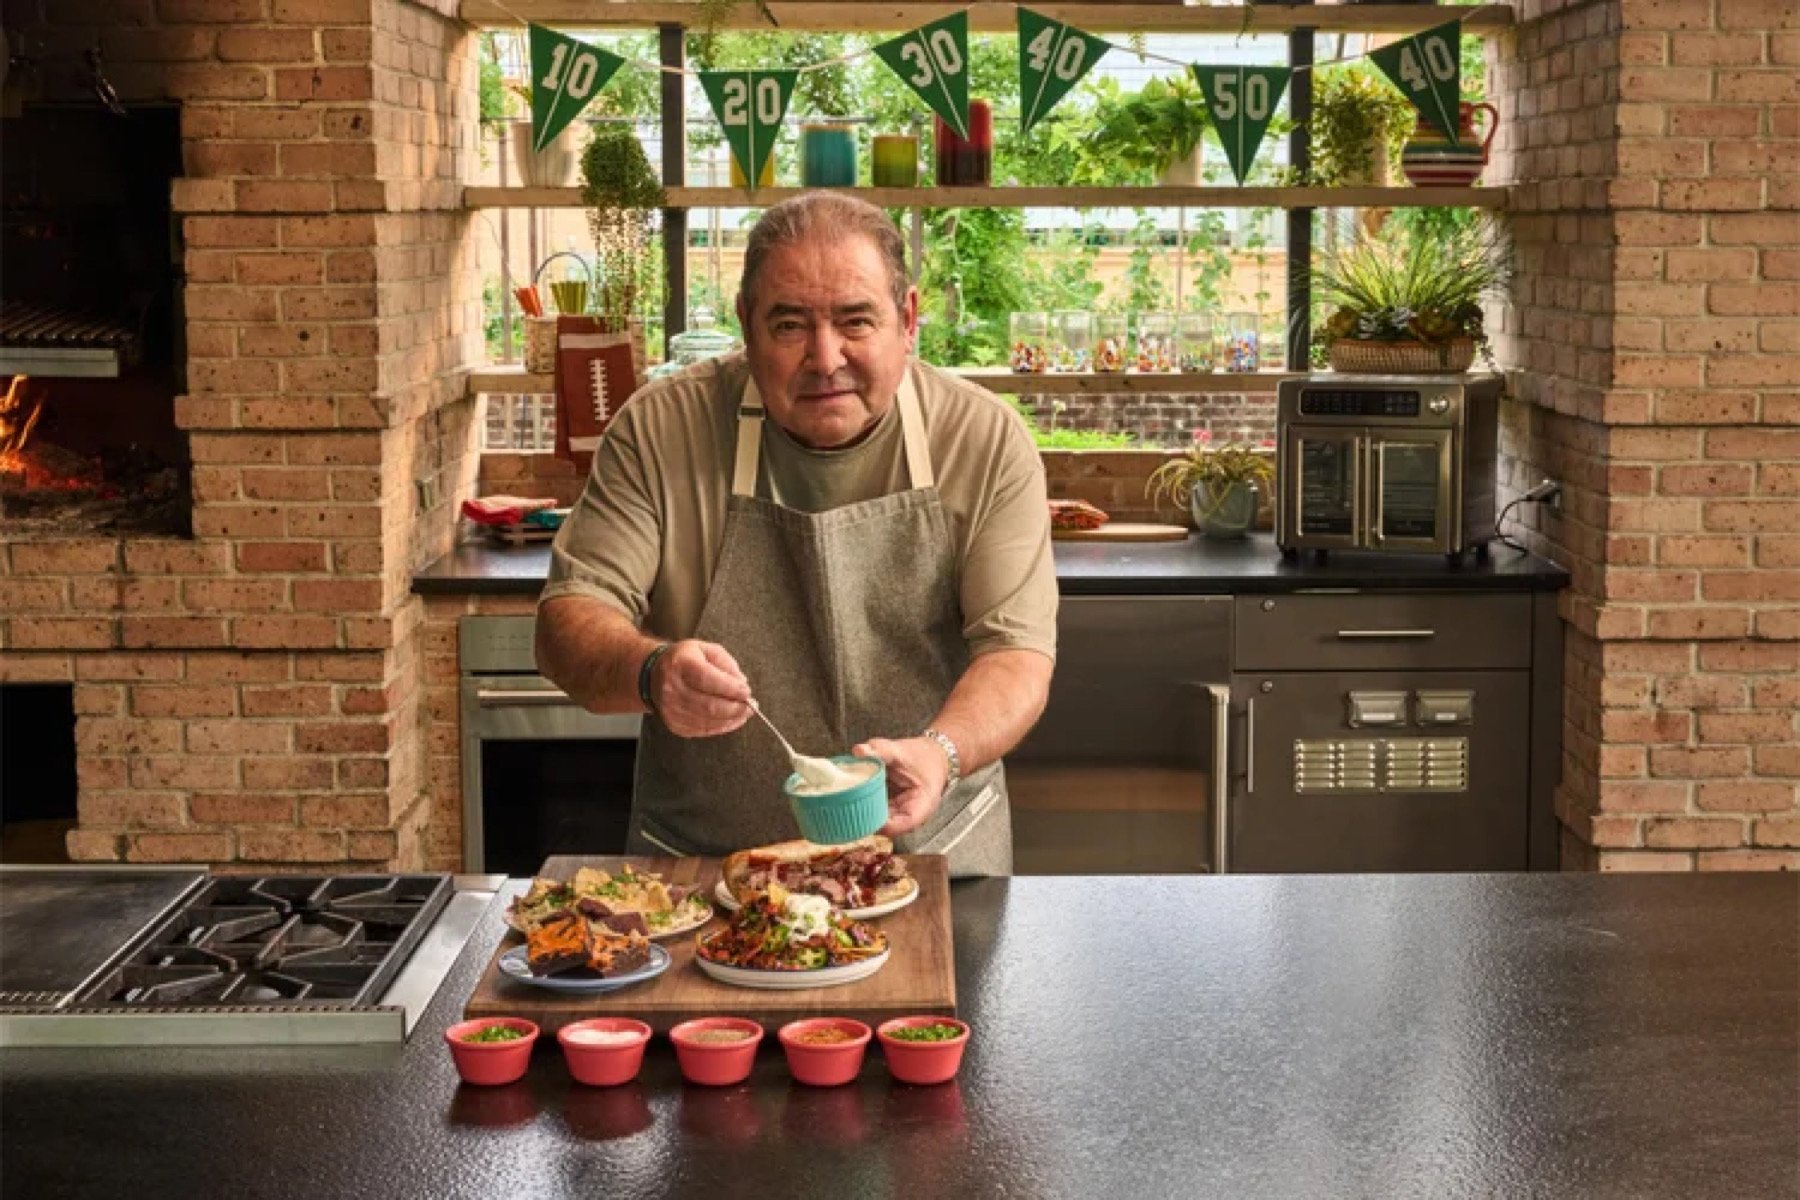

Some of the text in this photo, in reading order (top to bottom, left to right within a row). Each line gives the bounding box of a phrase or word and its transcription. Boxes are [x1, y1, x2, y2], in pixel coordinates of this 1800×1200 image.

[541, 42, 599, 100] 10
[901, 28, 963, 88] 30
[1026, 26, 1086, 80] 40
[1399, 35, 1456, 92] 40
[723, 78, 781, 126] 20
[1213, 73, 1268, 121] 50
